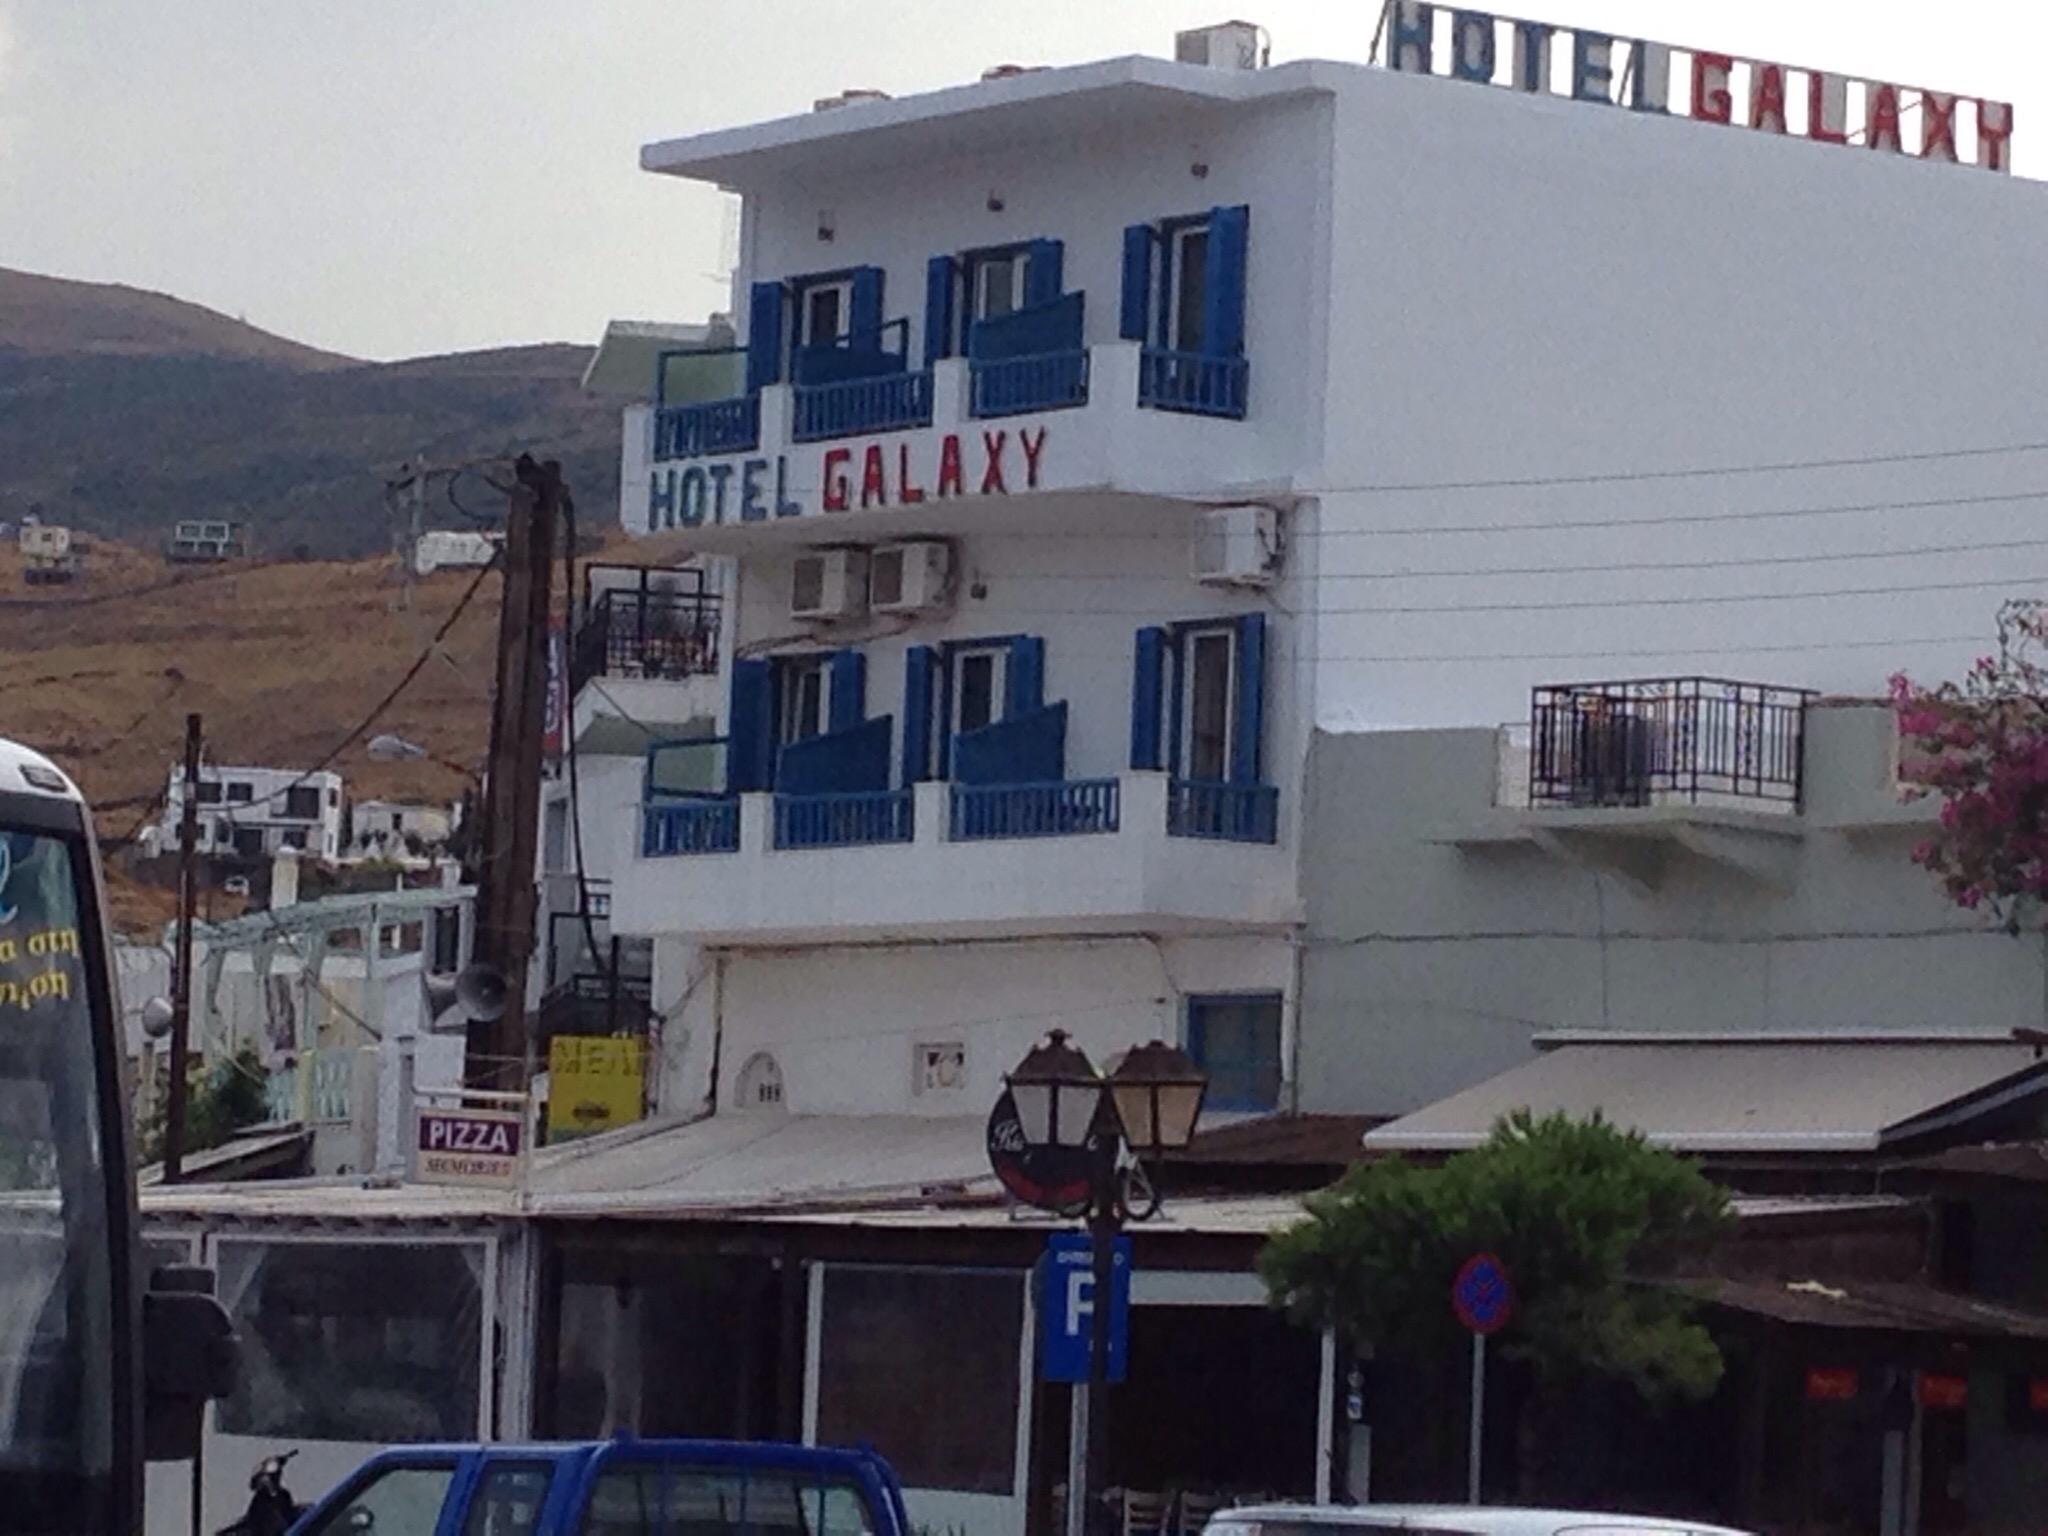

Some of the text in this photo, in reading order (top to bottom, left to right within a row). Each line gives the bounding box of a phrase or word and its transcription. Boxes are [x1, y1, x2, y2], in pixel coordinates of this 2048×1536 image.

[1387, 0, 2013, 172] HOTEL GALAXY
[649, 426, 1046, 532] HOTEL GALAXY
[429, 1120, 510, 1152] PIZZA
